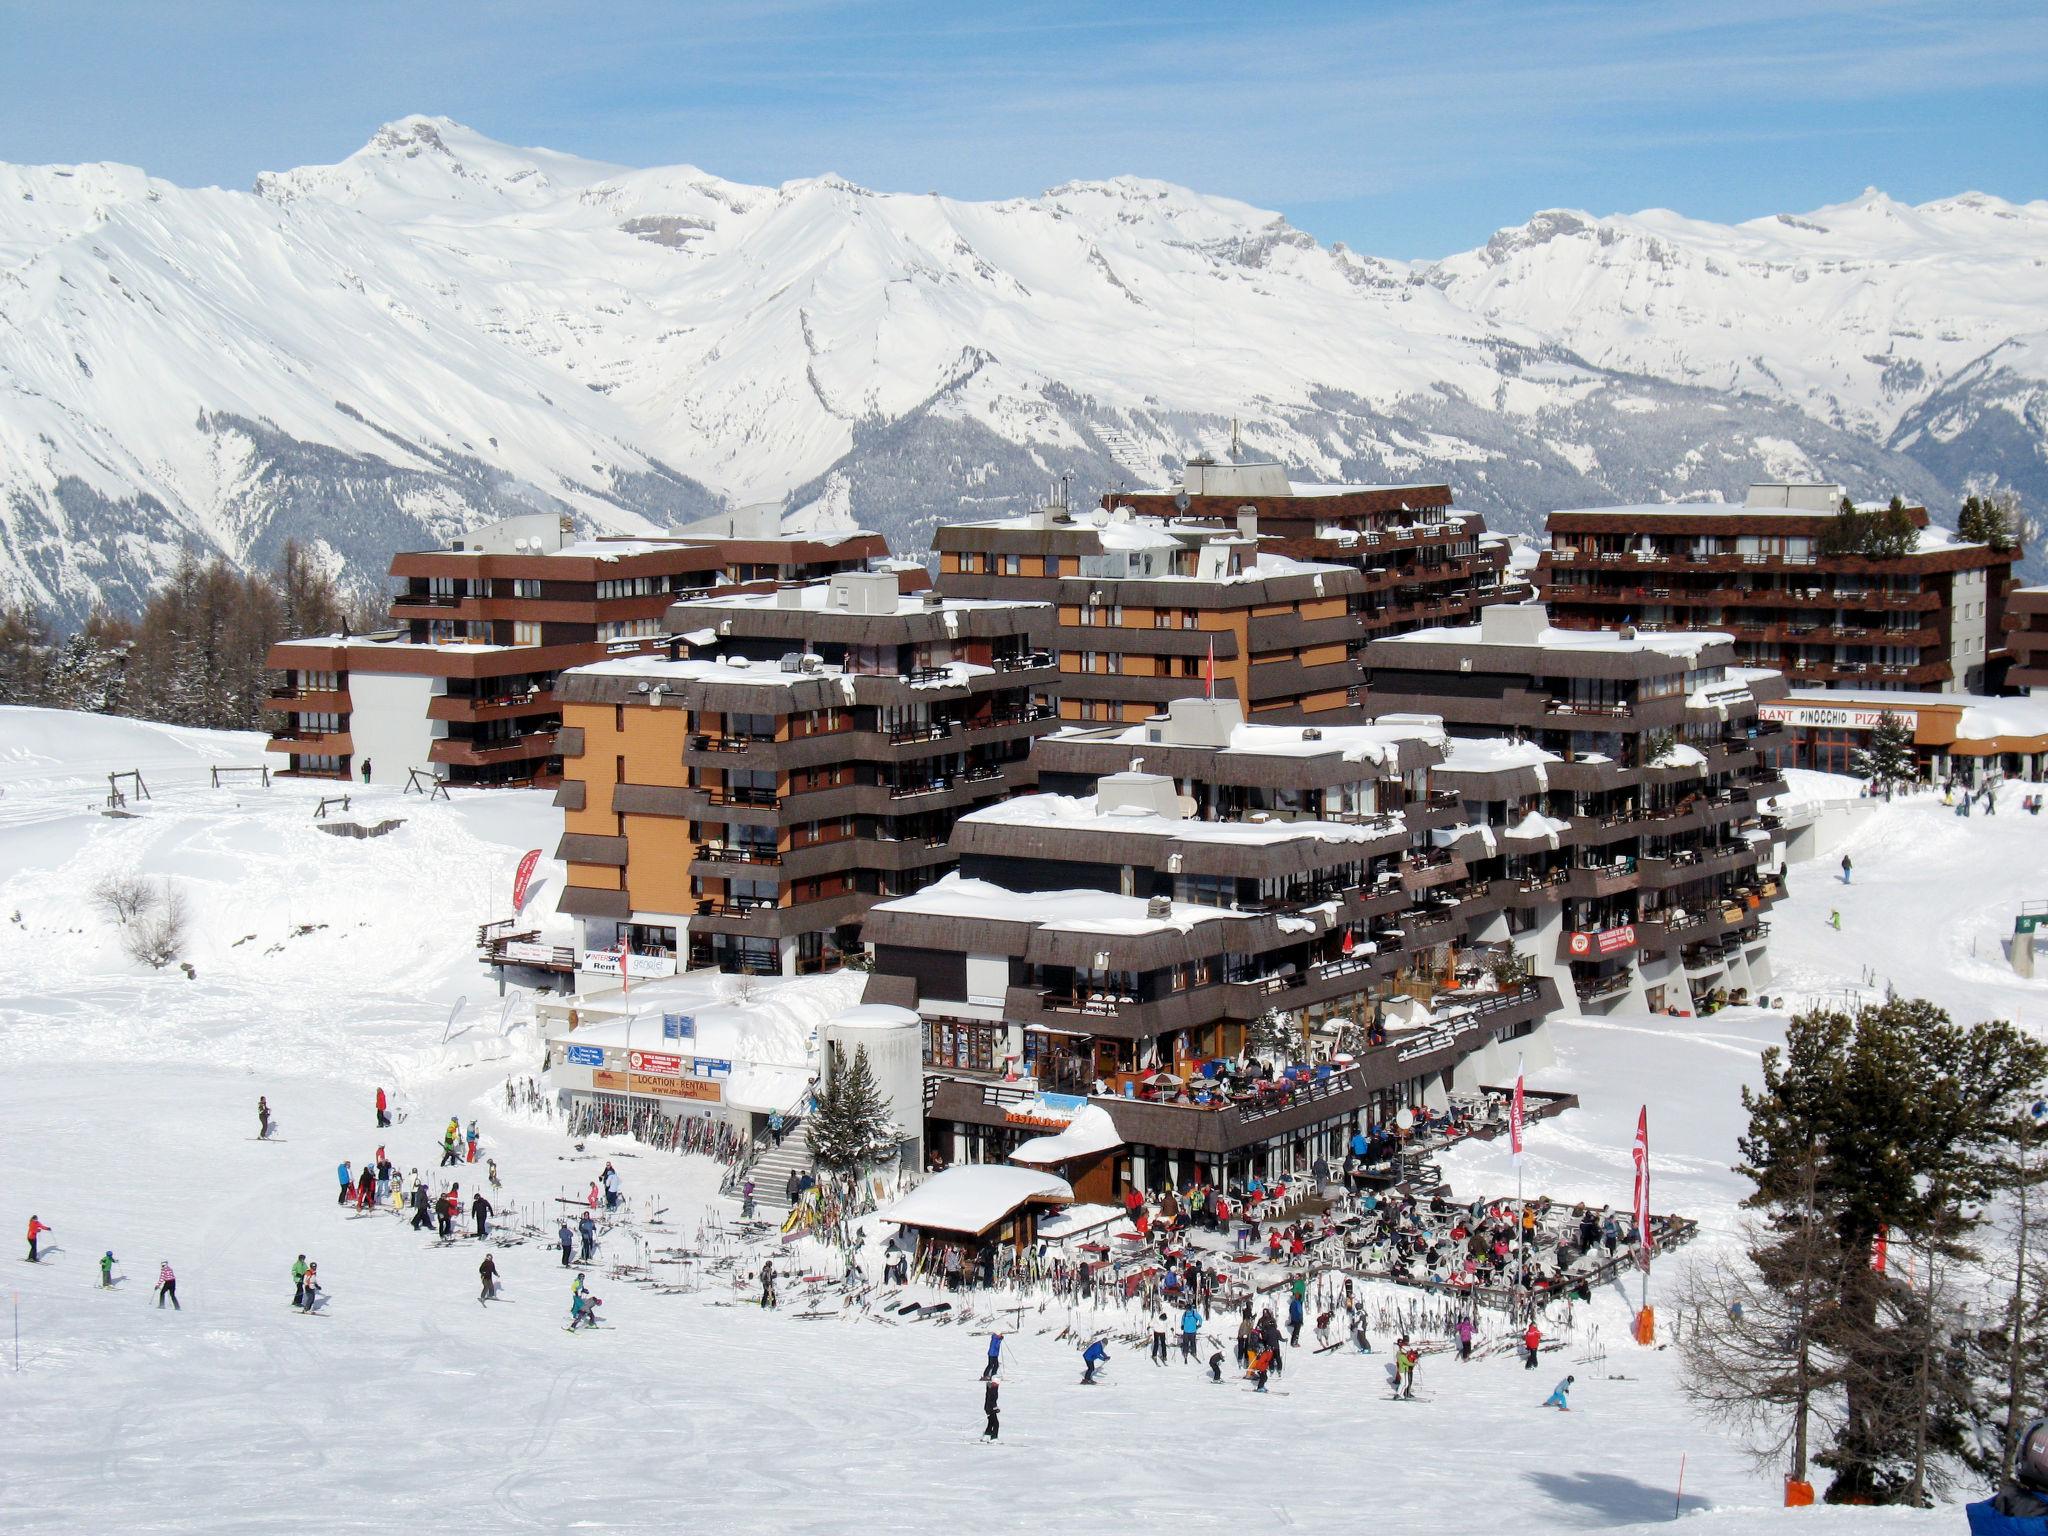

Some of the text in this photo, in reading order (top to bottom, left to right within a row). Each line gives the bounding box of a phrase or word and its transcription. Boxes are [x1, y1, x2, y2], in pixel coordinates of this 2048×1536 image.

[1800, 709, 1847, 724] PINOCCHIO
[1855, 713, 1914, 727] PIZZRIA
[591, 953, 621, 962] INTERSPO
[593, 962, 615, 970] Rent
[638, 1075, 675, 1087] LOCATION
[681, 1080, 709, 1091] RENTAL
